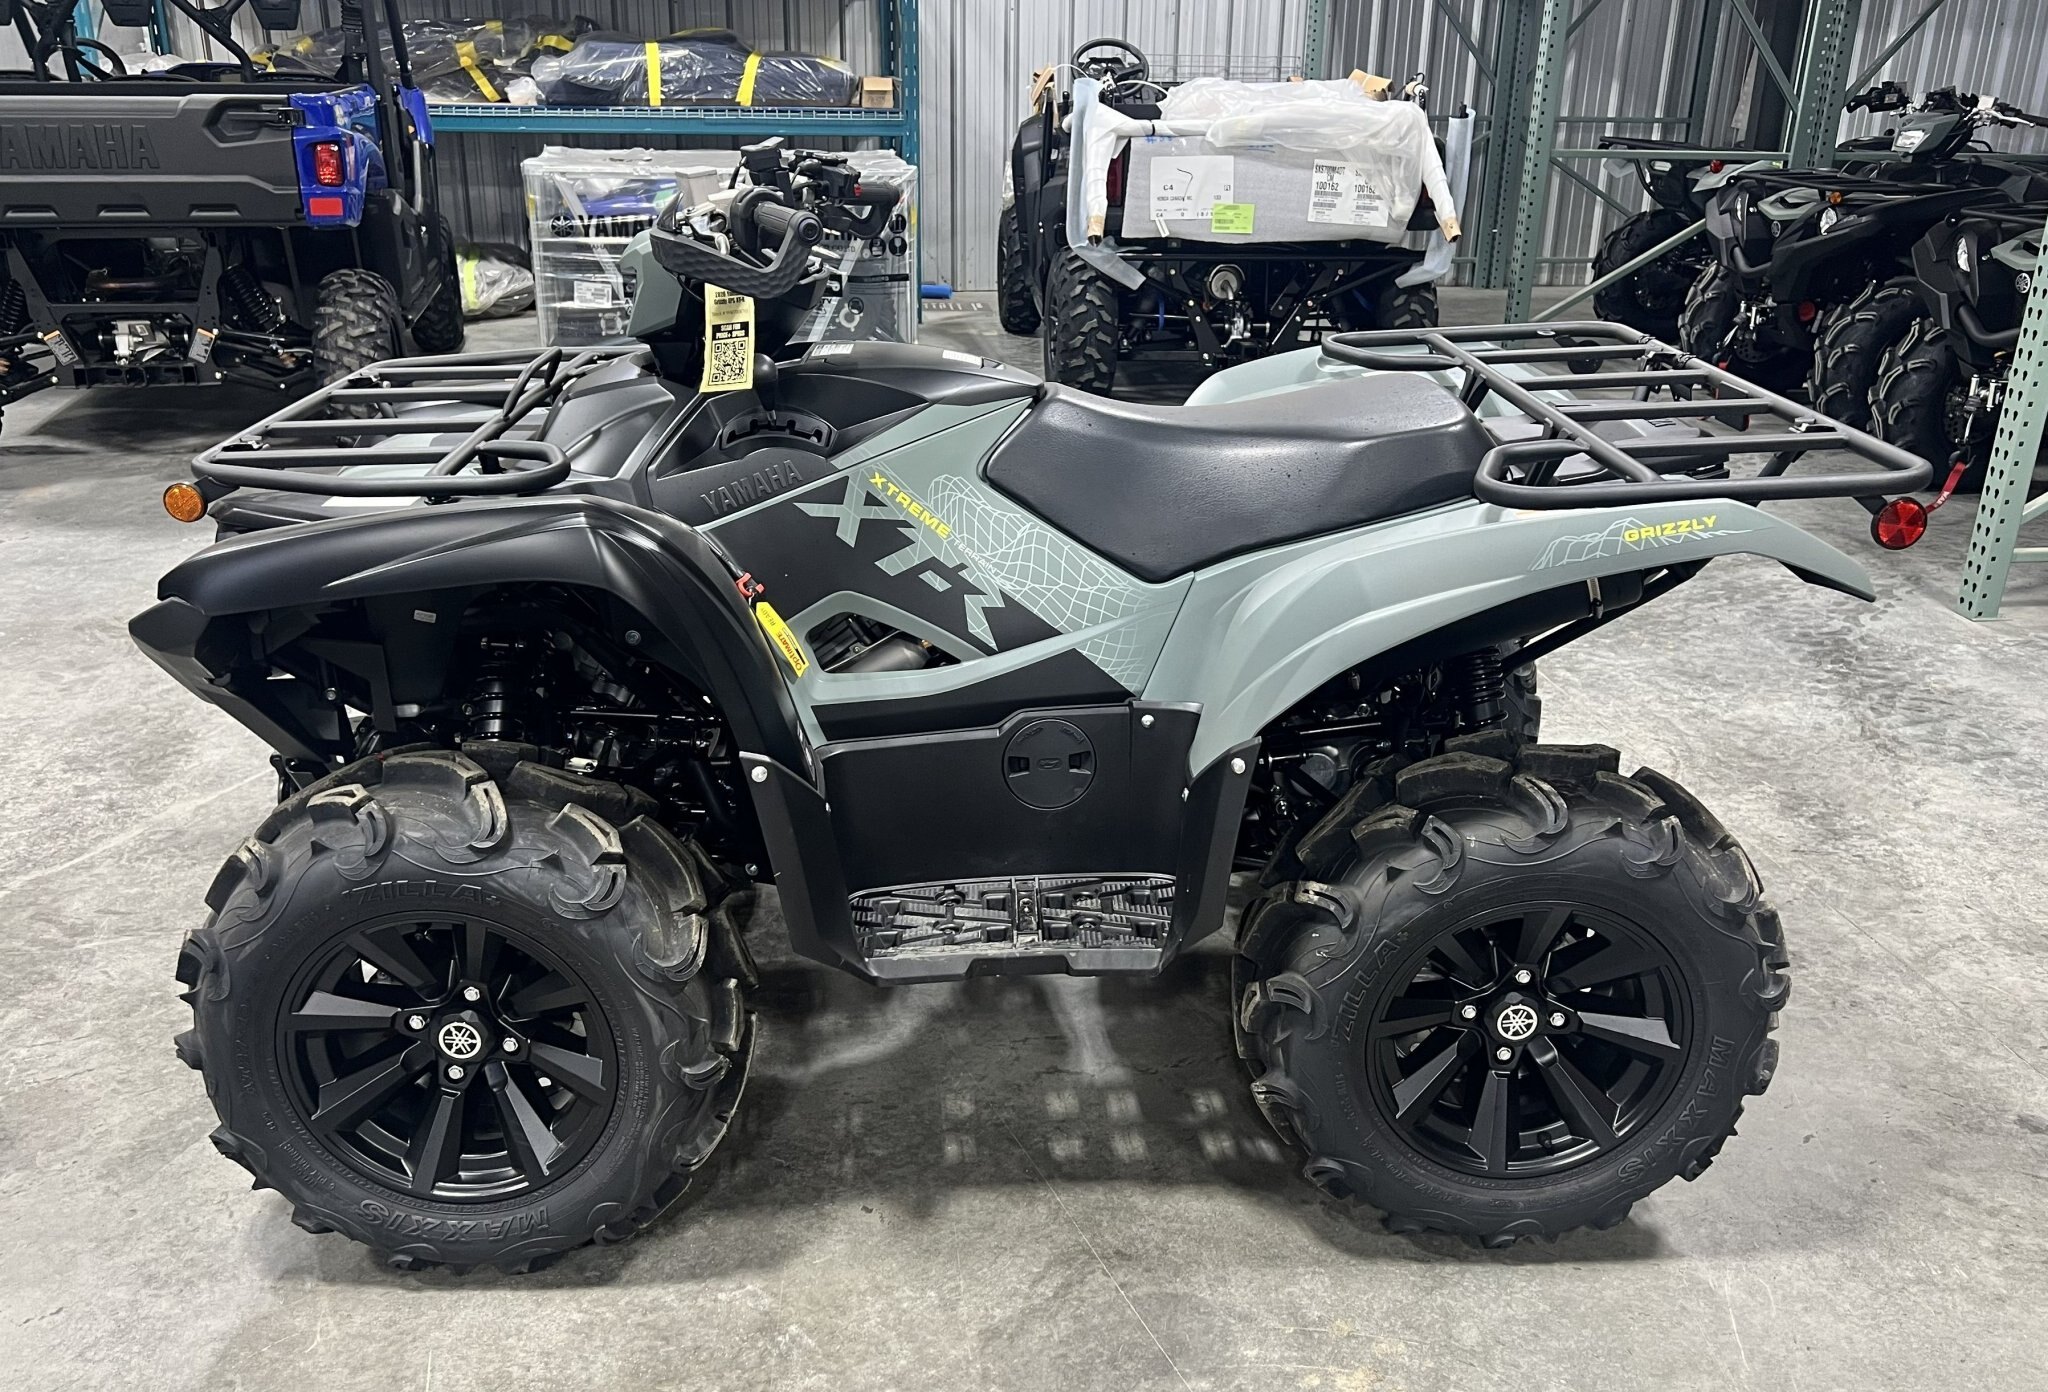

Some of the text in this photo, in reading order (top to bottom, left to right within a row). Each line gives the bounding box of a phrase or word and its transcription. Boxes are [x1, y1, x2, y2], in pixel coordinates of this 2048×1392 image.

[0, 124, 160, 169] AMAHA
[1315, 181, 1339, 191] 100162
[577, 214, 656, 238] YAMA
[700, 460, 803, 515] YAMAHA
[869, 471, 999, 575] XTREME TERRAIN
[1624, 515, 1717, 542] GRIZZLY
[761, 608, 776, 627] READY
[1617, 1034, 1735, 1182] MAXXIS
[356, 1200, 549, 1241] MAXXIS
